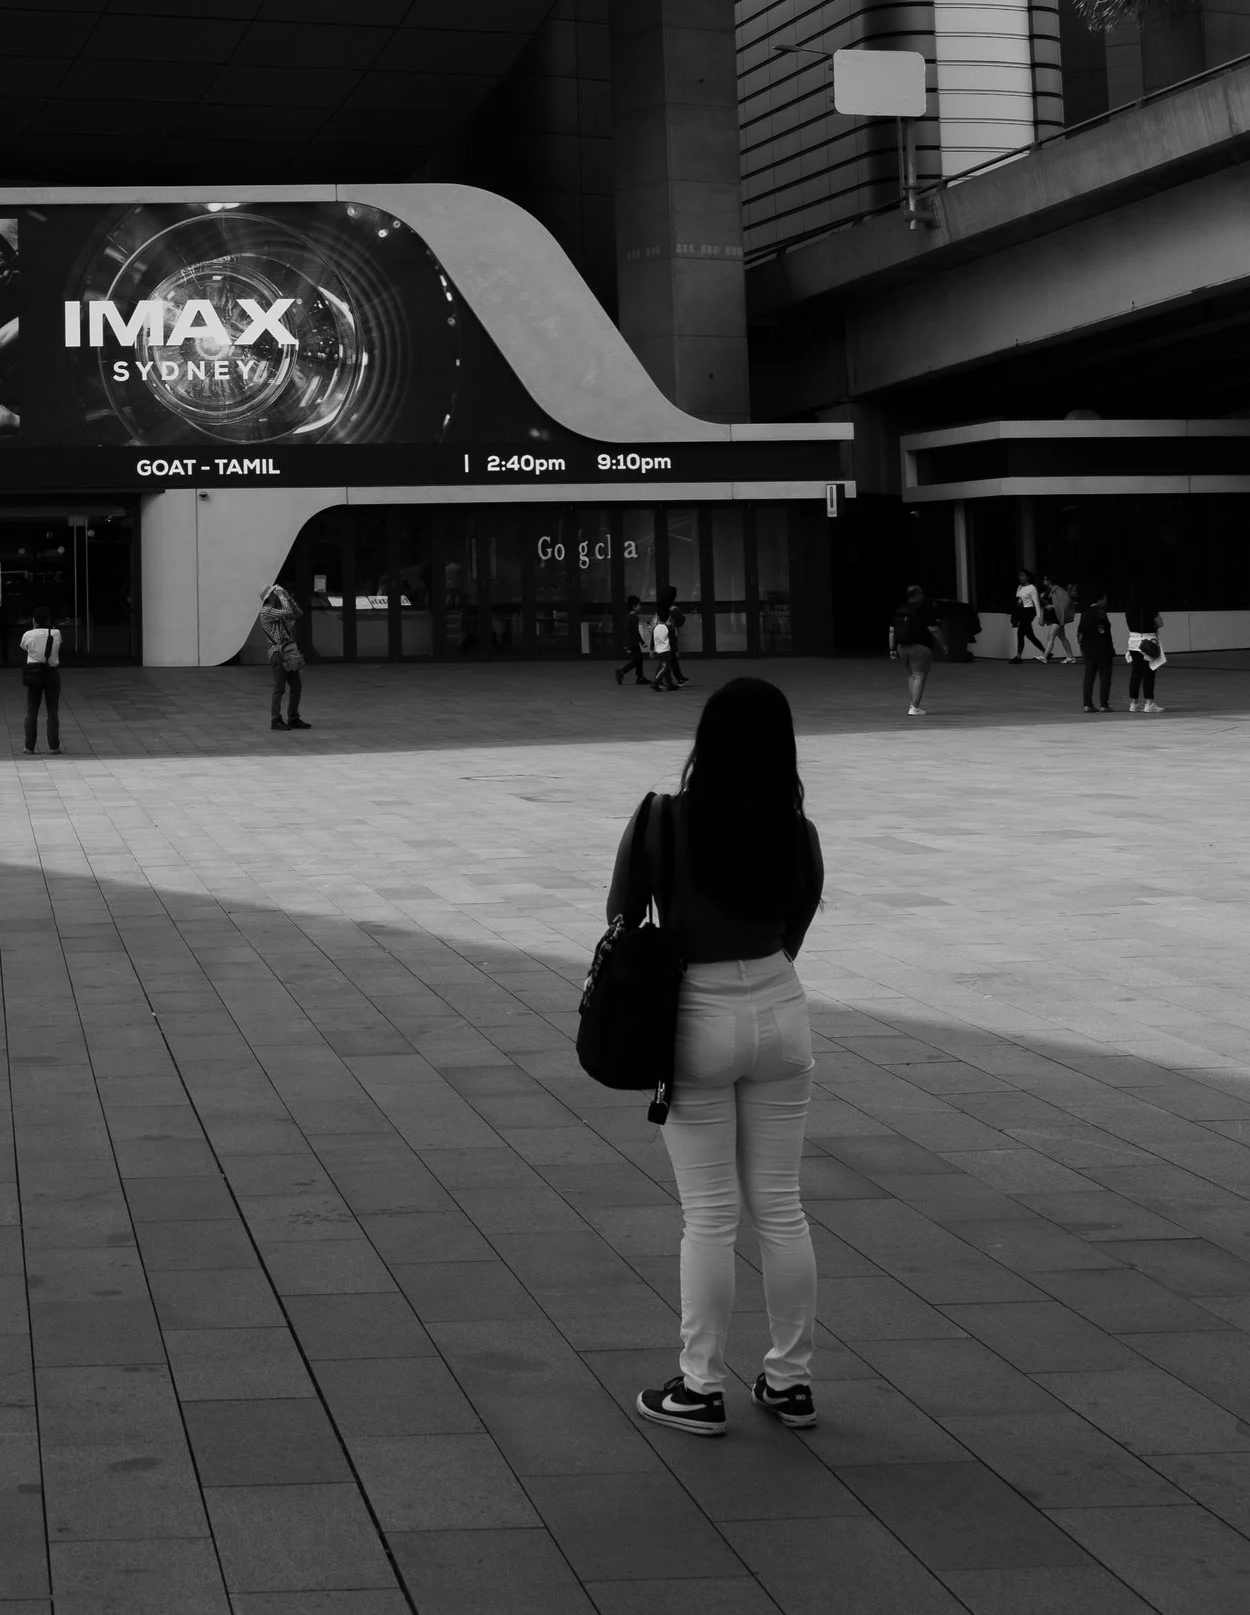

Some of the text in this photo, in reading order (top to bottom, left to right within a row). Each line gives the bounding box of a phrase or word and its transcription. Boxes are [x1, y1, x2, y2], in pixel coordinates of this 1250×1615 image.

[65, 298, 299, 347] IMAX
[112, 360, 255, 382] SYDNEY
[136, 459, 197, 477] GOAT
[214, 458, 281, 476] TAMIL
[487, 453, 672, 474] 2:40pm 9:10pm
